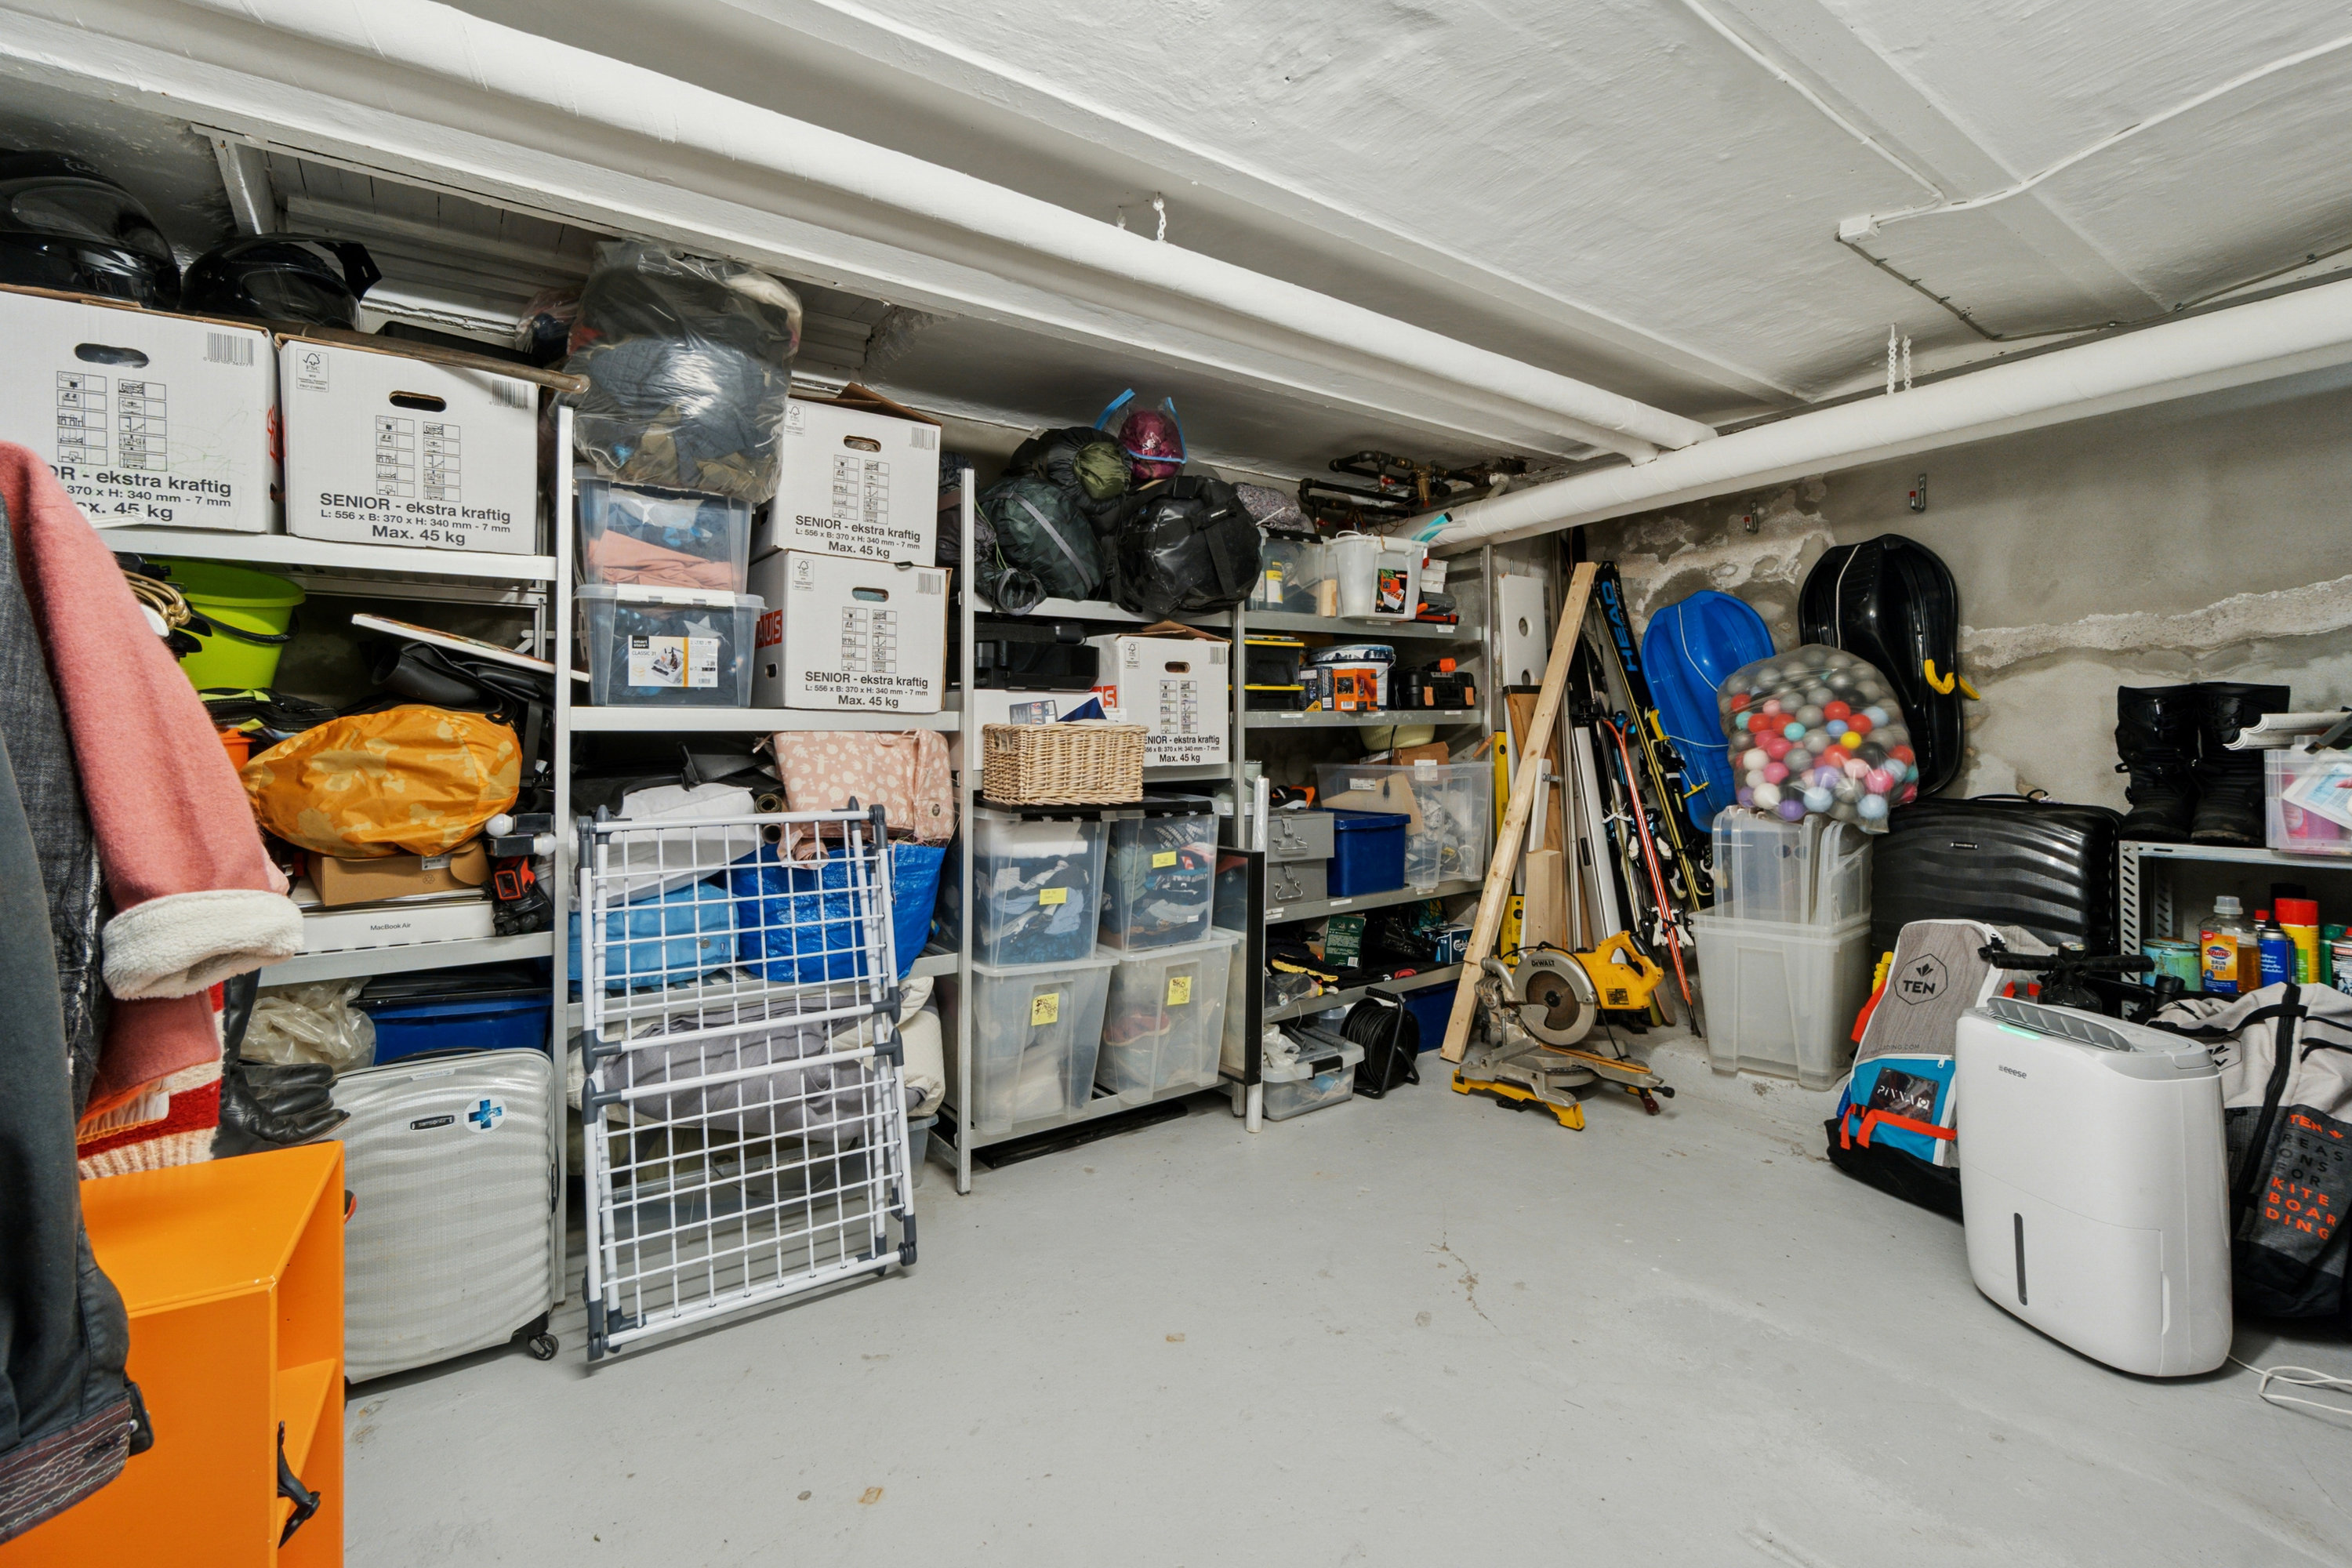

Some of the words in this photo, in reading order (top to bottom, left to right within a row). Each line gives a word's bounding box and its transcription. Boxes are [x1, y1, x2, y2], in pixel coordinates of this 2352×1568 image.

[96, 471, 162, 488] ekstra
[169, 476, 230, 497] kraftig
[67, 485, 92, 495] 370
[109, 488, 122, 498] H:
[128, 491, 151, 500] 340
[156, 494, 180, 503] mm
[207, 498, 230, 507] mm
[147, 504, 172, 521] kg
[321, 493, 390, 510] SENIOR
[406, 502, 456, 517] ekstra
[462, 506, 510, 524] kraftig
[321, 510, 331, 518] L:
[335, 511, 355, 520] 556
[369, 513, 380, 521] B:
[430, 518, 448, 528] 340
[372, 525, 414, 539] Max.
[419, 530, 440, 541] 45
[445, 532, 465, 546] kg
[796, 515, 841, 530] SENIOR
[851, 523, 884, 535] ekstra
[888, 528, 920, 543] kraftig
[829, 541, 855, 553] Max.
[860, 545, 873, 554] 45
[877, 546, 890, 559] kg
[1602, 581, 1639, 671] HEAD
[805, 671, 850, 683] SENIOR
[860, 676, 893, 685] ekstra
[897, 677, 928, 688] kraftig
[838, 695, 865, 705] Max.
[869, 697, 882, 706] 45
[885, 697, 898, 708] kg
[1198, 736, 1219, 745] kraftig
[1192, 753, 1200, 763] kg
[1904, 980, 1936, 994] TEN
[2289, 1114, 2323, 1133] TEN
[2282, 1134, 2343, 1162] REAS
[2279, 1149, 2328, 1173] ONS
[2277, 1161, 2321, 1187] FOR
[2271, 1177, 2329, 1207] KITE
[2268, 1192, 2337, 1227] BOAR
[2266, 1207, 2329, 1240] DING
